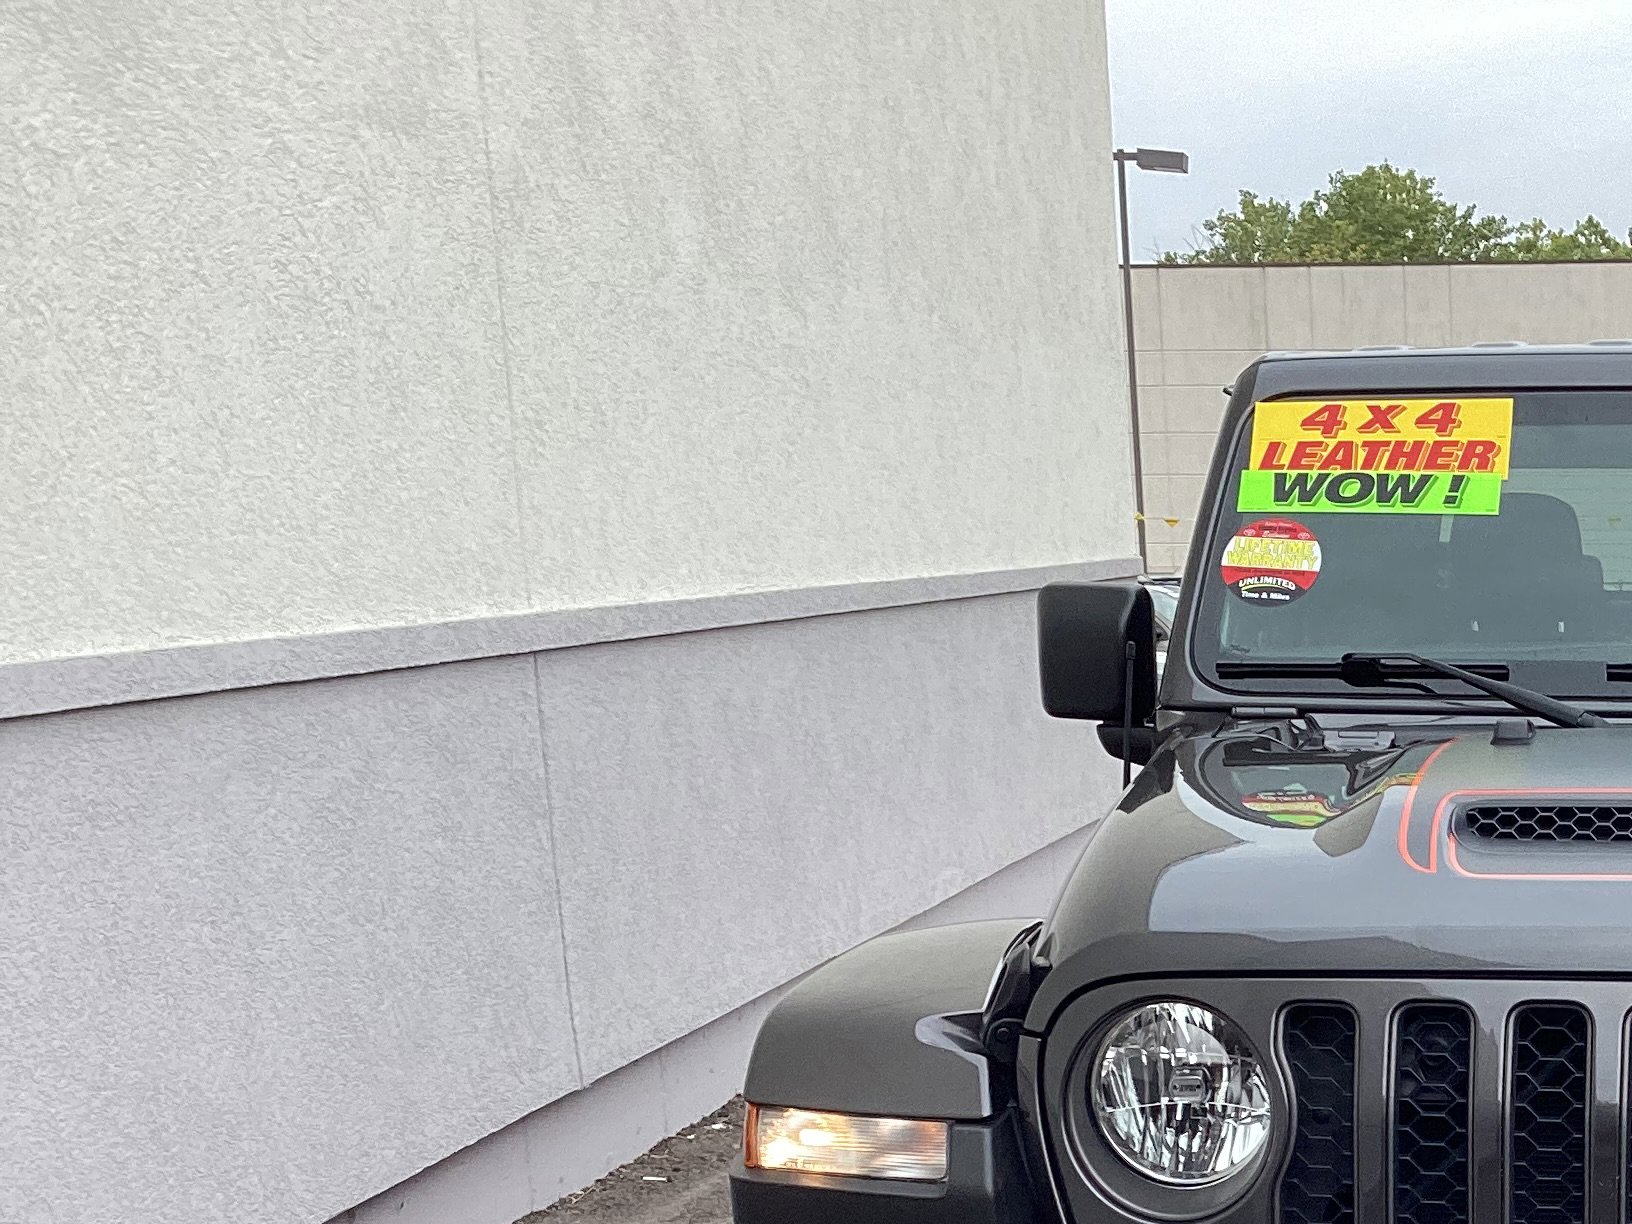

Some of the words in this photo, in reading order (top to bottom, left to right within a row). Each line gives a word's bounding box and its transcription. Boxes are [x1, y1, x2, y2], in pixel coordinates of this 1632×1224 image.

[1258, 439, 1502, 473] LEATHER
[1234, 536, 1315, 556] LIFETIME
[1227, 550, 1318, 571] WARRANTY
[1238, 575, 1296, 591] UNLIMITED
[1241, 590, 1260, 599] Time
